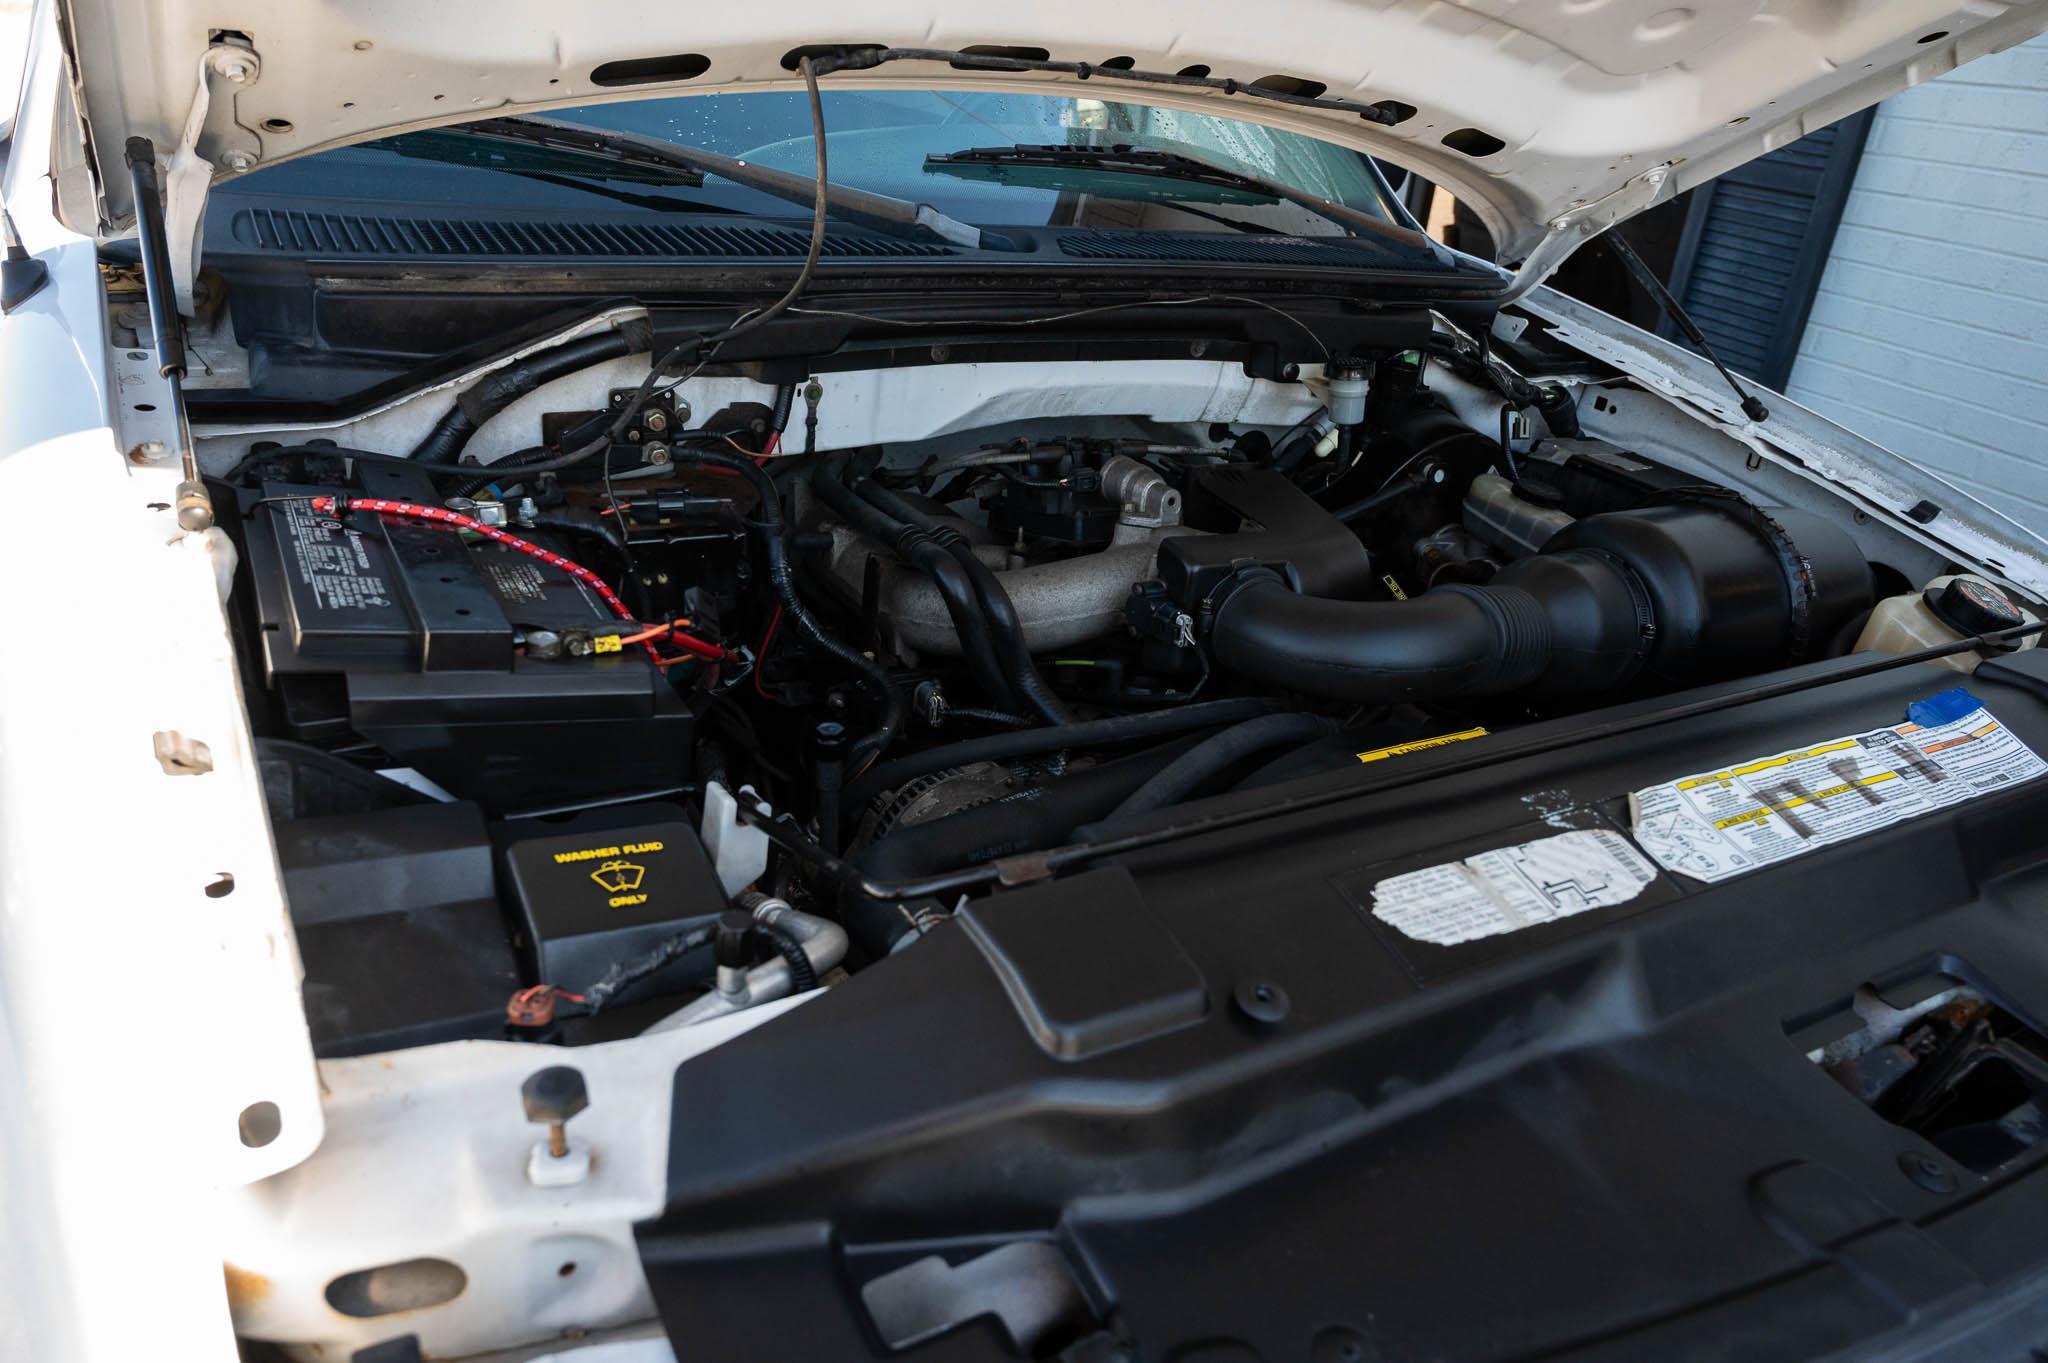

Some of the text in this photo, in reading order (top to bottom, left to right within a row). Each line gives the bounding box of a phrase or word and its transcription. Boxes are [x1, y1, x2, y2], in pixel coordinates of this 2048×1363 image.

[553, 841, 664, 863] WASHER FLUID
[609, 894, 647, 908] ONLY
